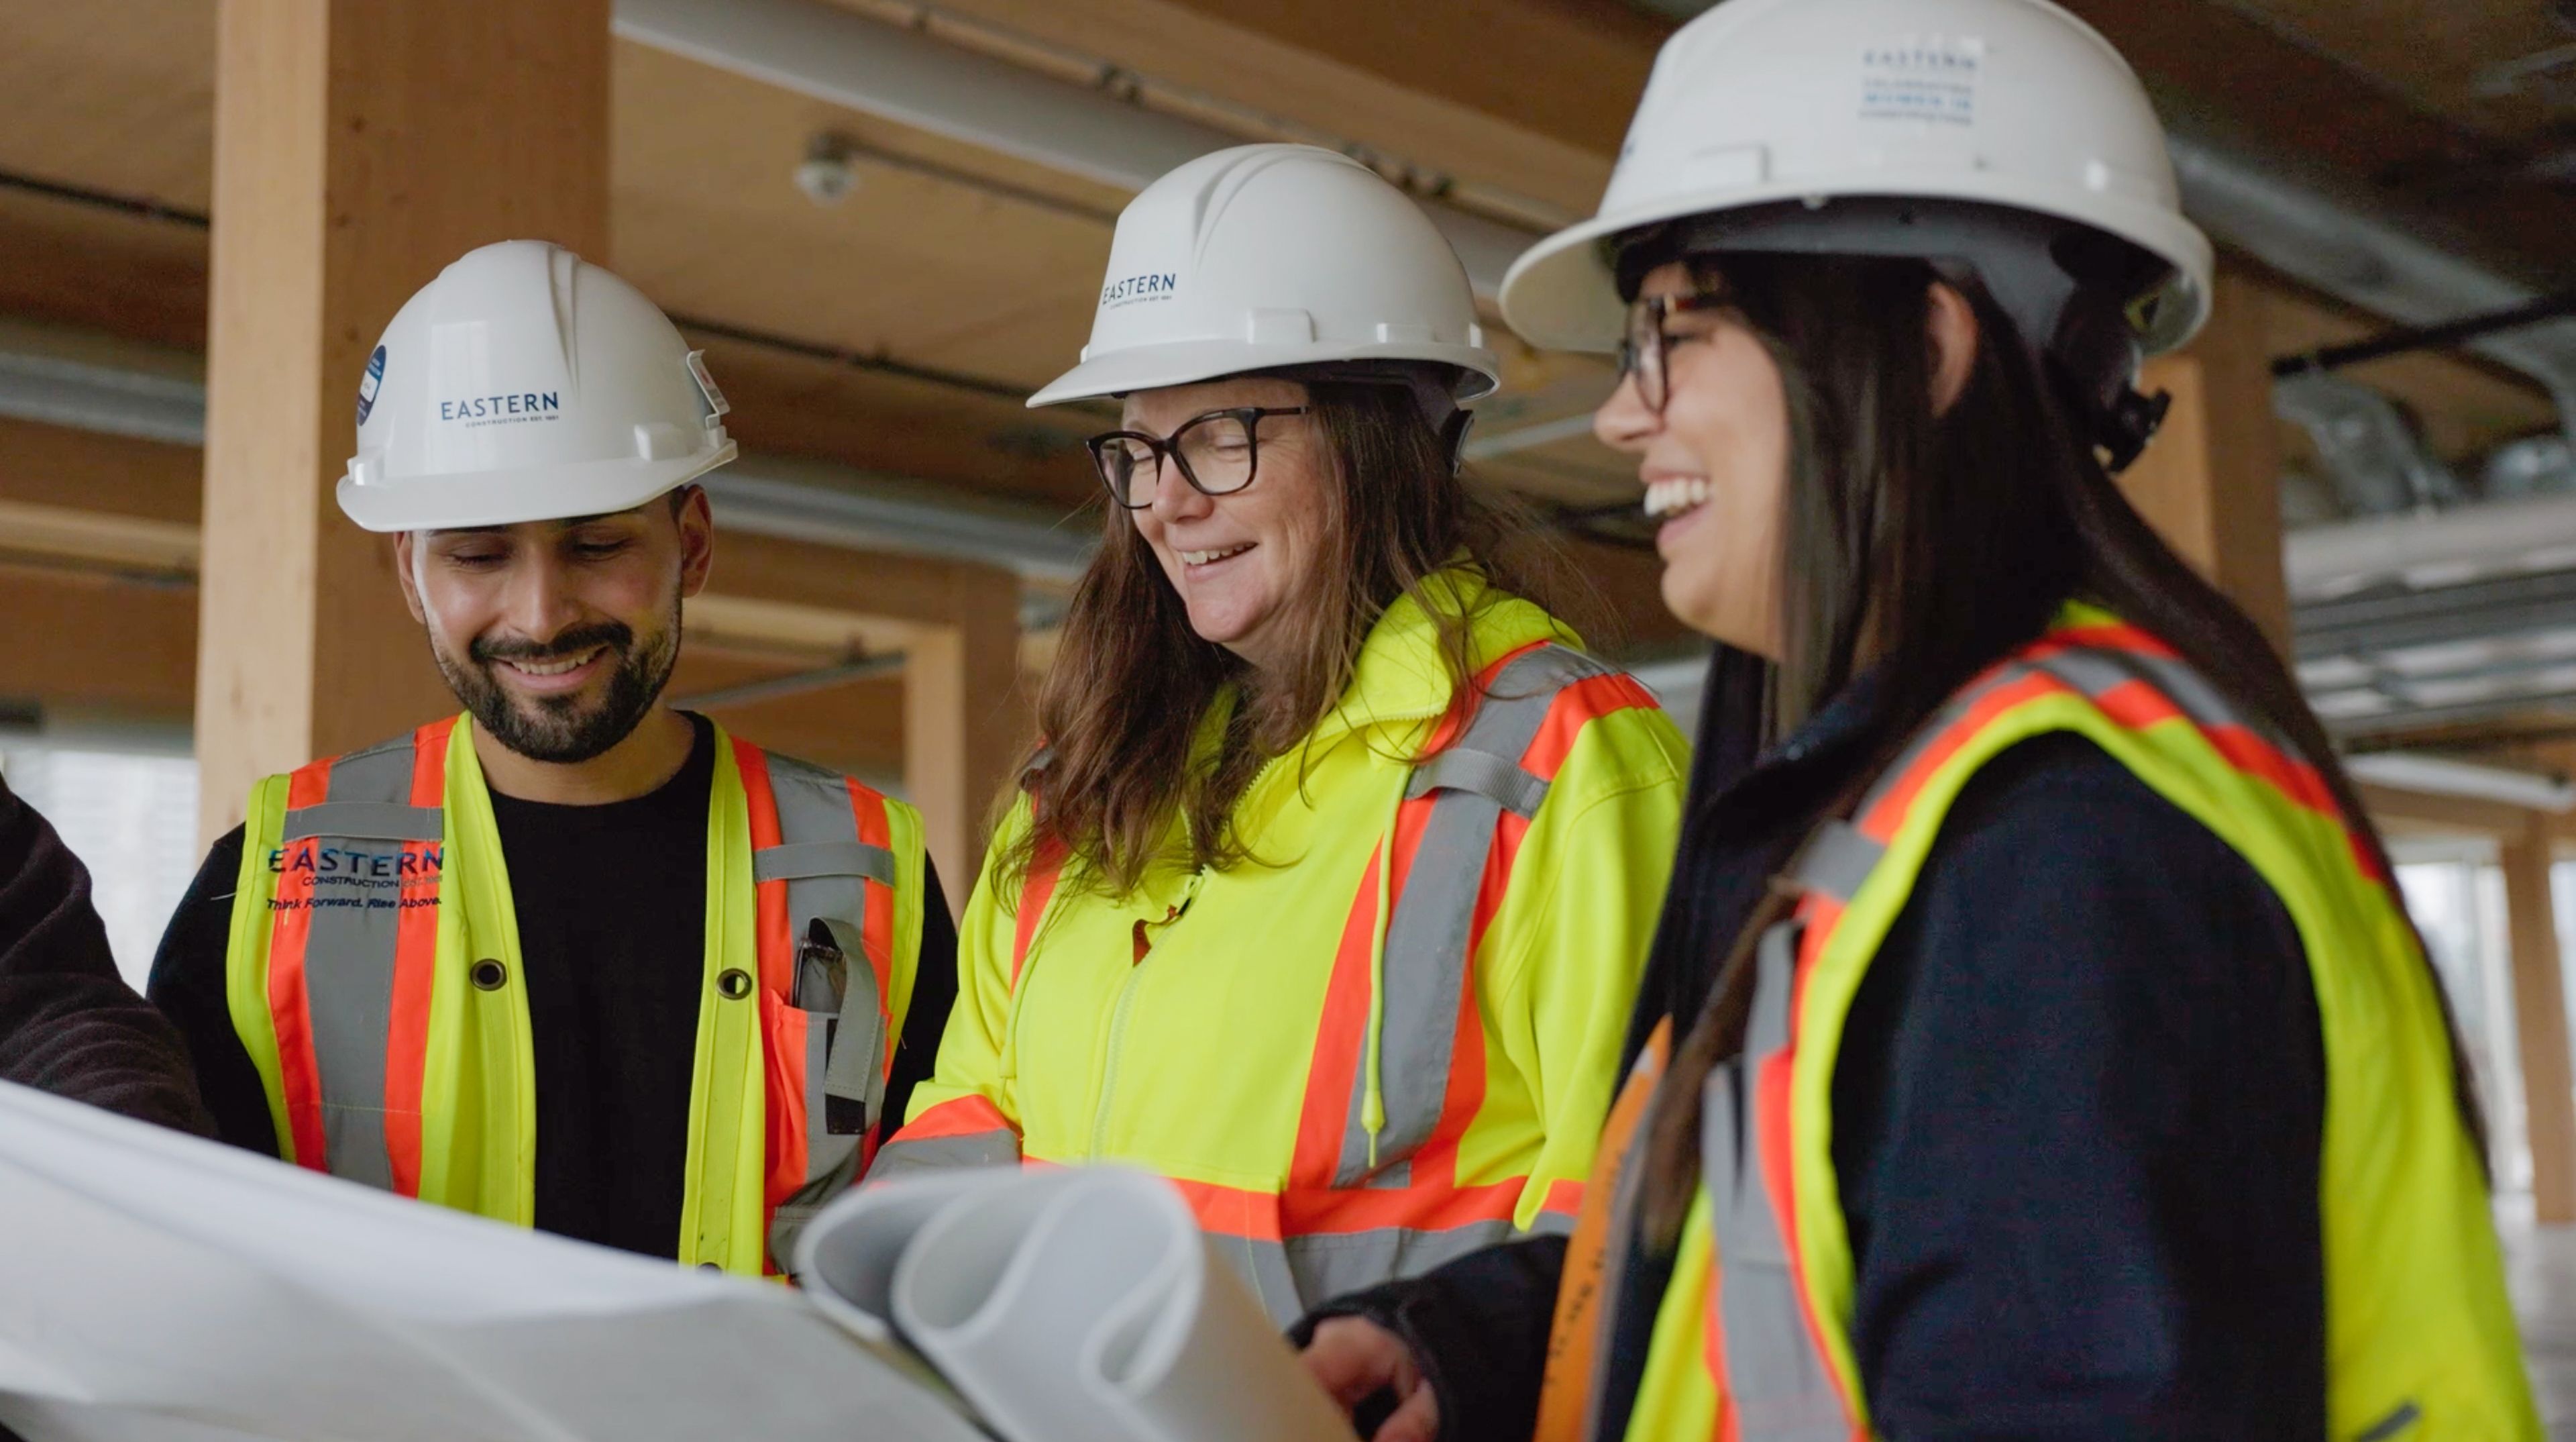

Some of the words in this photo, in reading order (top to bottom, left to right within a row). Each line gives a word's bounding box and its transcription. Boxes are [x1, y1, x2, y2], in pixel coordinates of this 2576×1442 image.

[1103, 273, 1175, 305] EASTERN
[441, 392, 559, 420] EASTERN
[466, 417, 527, 427] CONSTRUCTION
[268, 847, 444, 876] EASTERN
[303, 876, 399, 888] CONSTRUCTION
[267, 898, 301, 911] Think
[305, 898, 363, 909] Forward.
[367, 897, 396, 909] Rise
[398, 896, 441, 909] Above.
